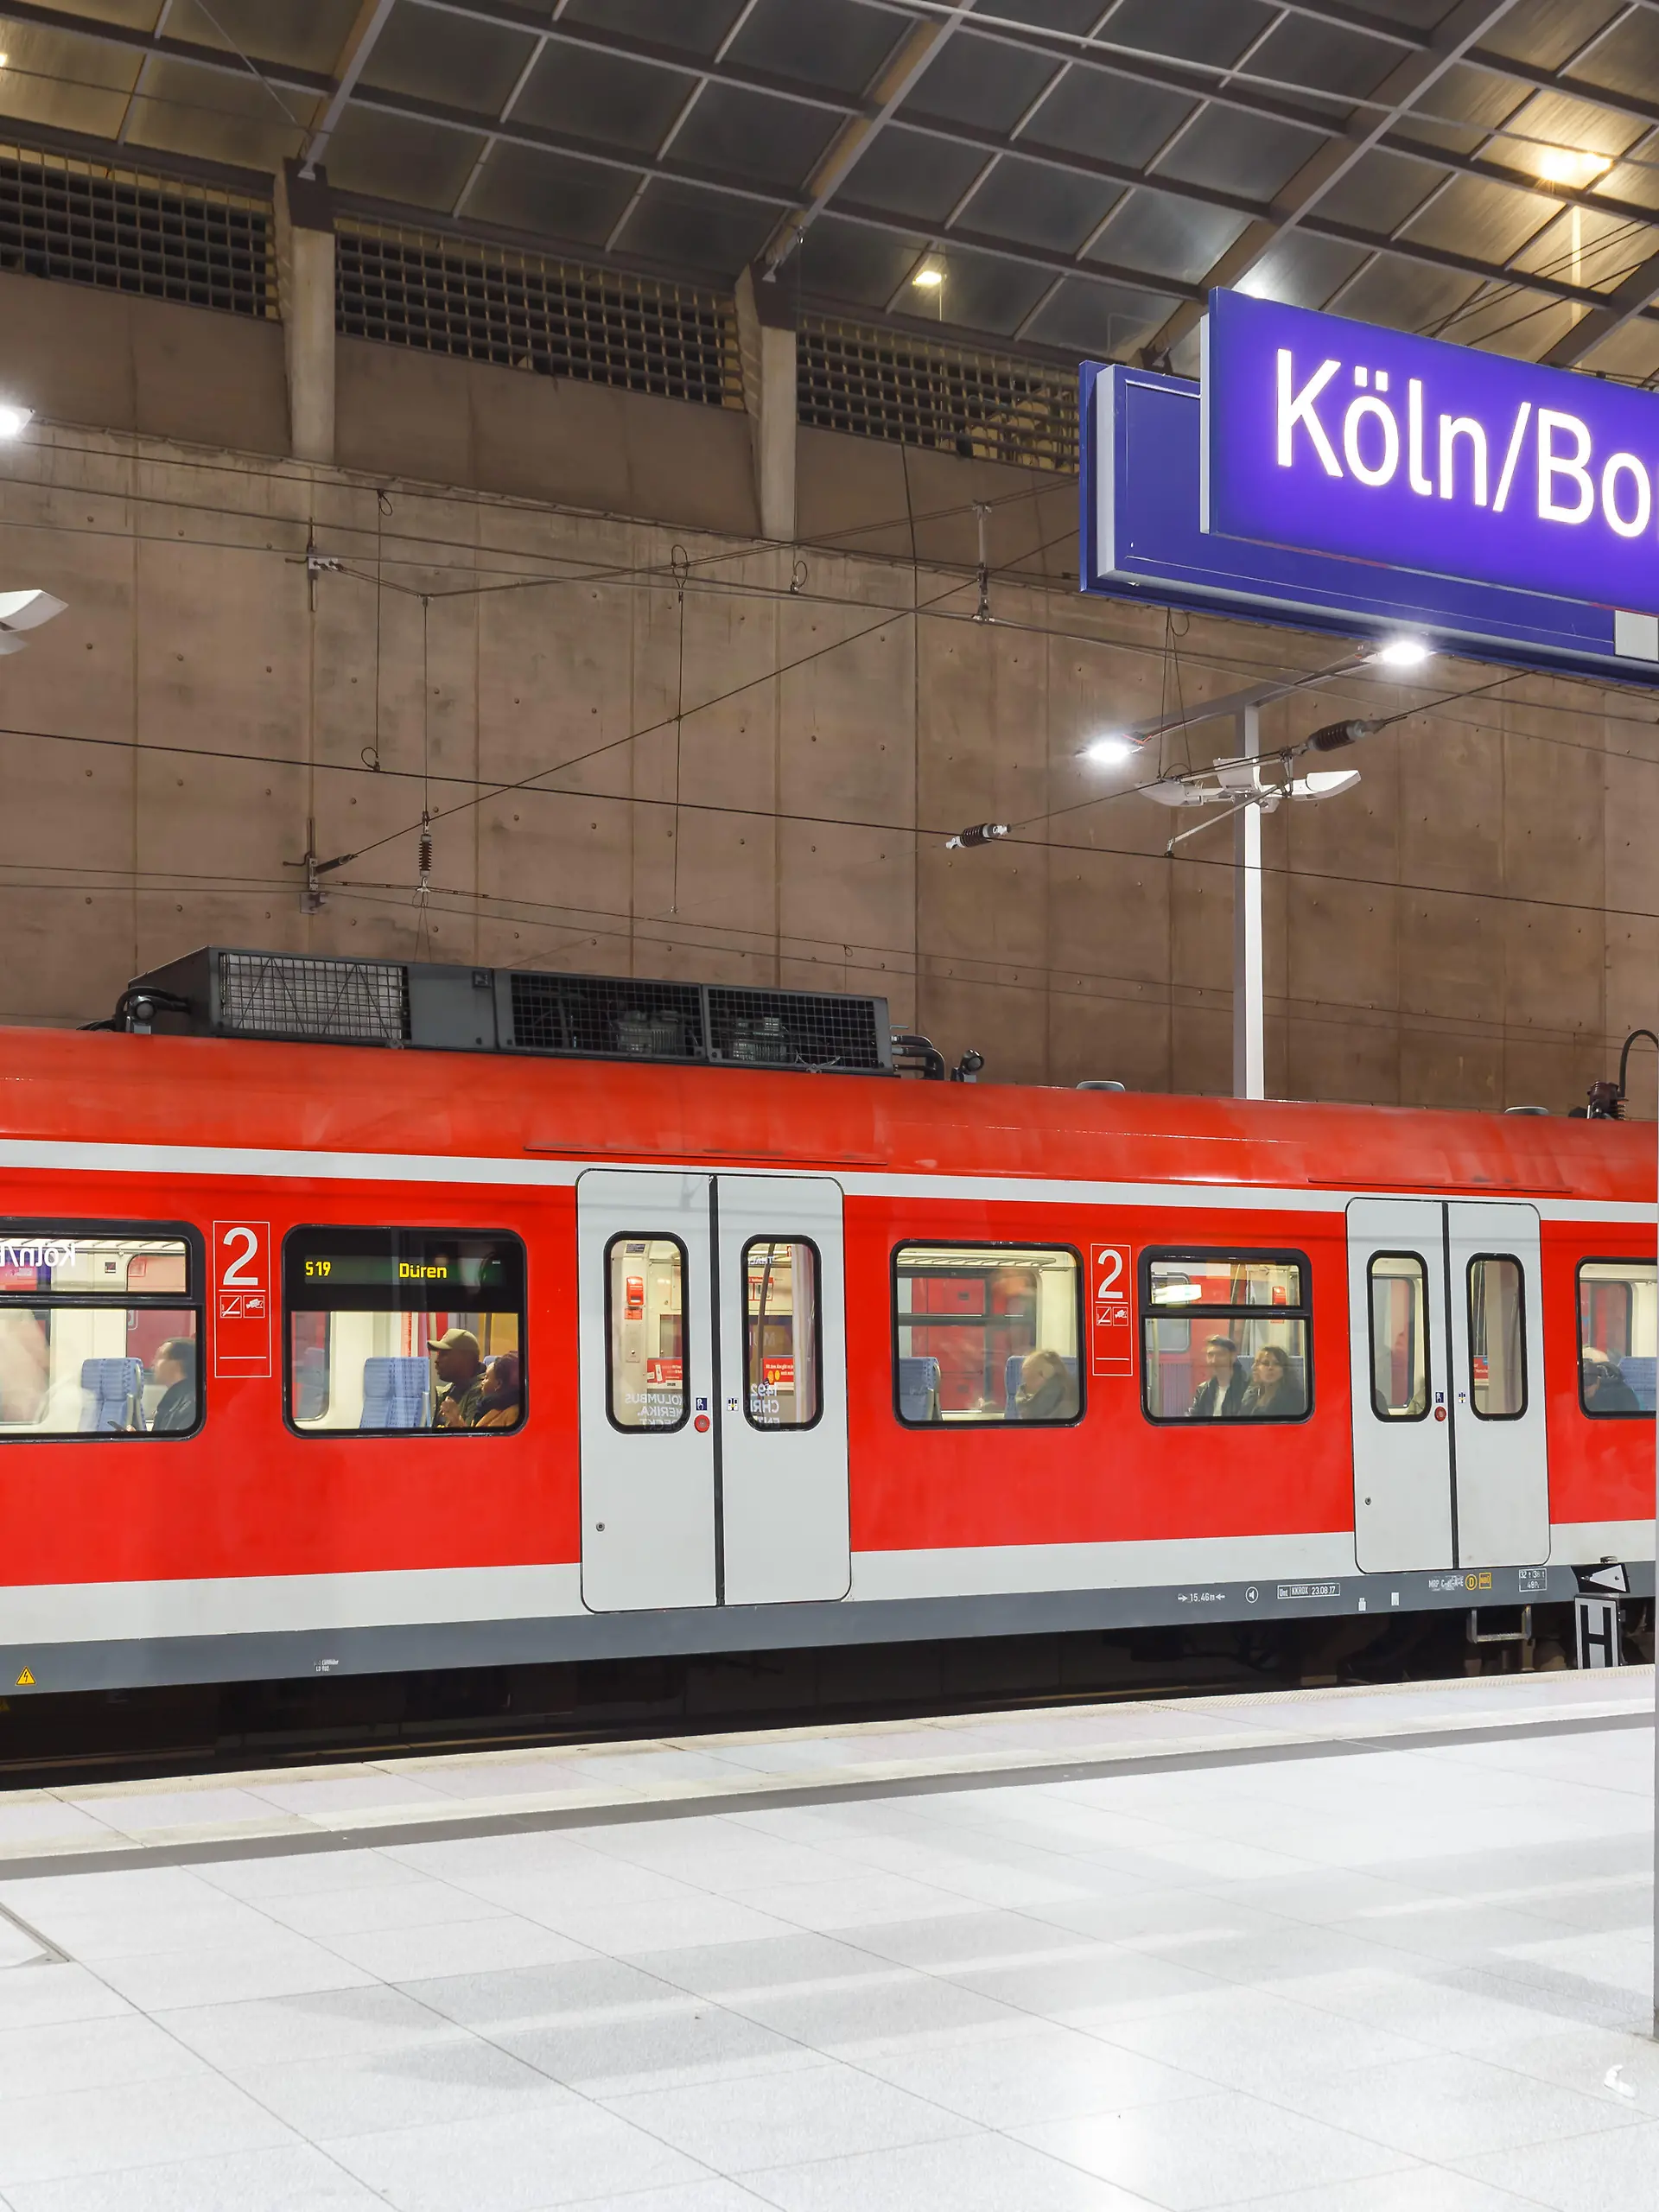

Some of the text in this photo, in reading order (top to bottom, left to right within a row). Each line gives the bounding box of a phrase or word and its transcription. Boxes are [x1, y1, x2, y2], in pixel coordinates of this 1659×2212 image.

[1277, 348, 1658, 537] Köln/Bo
[223, 1227, 258, 1286] 2
[399, 1262, 447, 1278] Düren
[1097, 1249, 1123, 1299] 2
[1580, 1604, 1613, 1669] H
